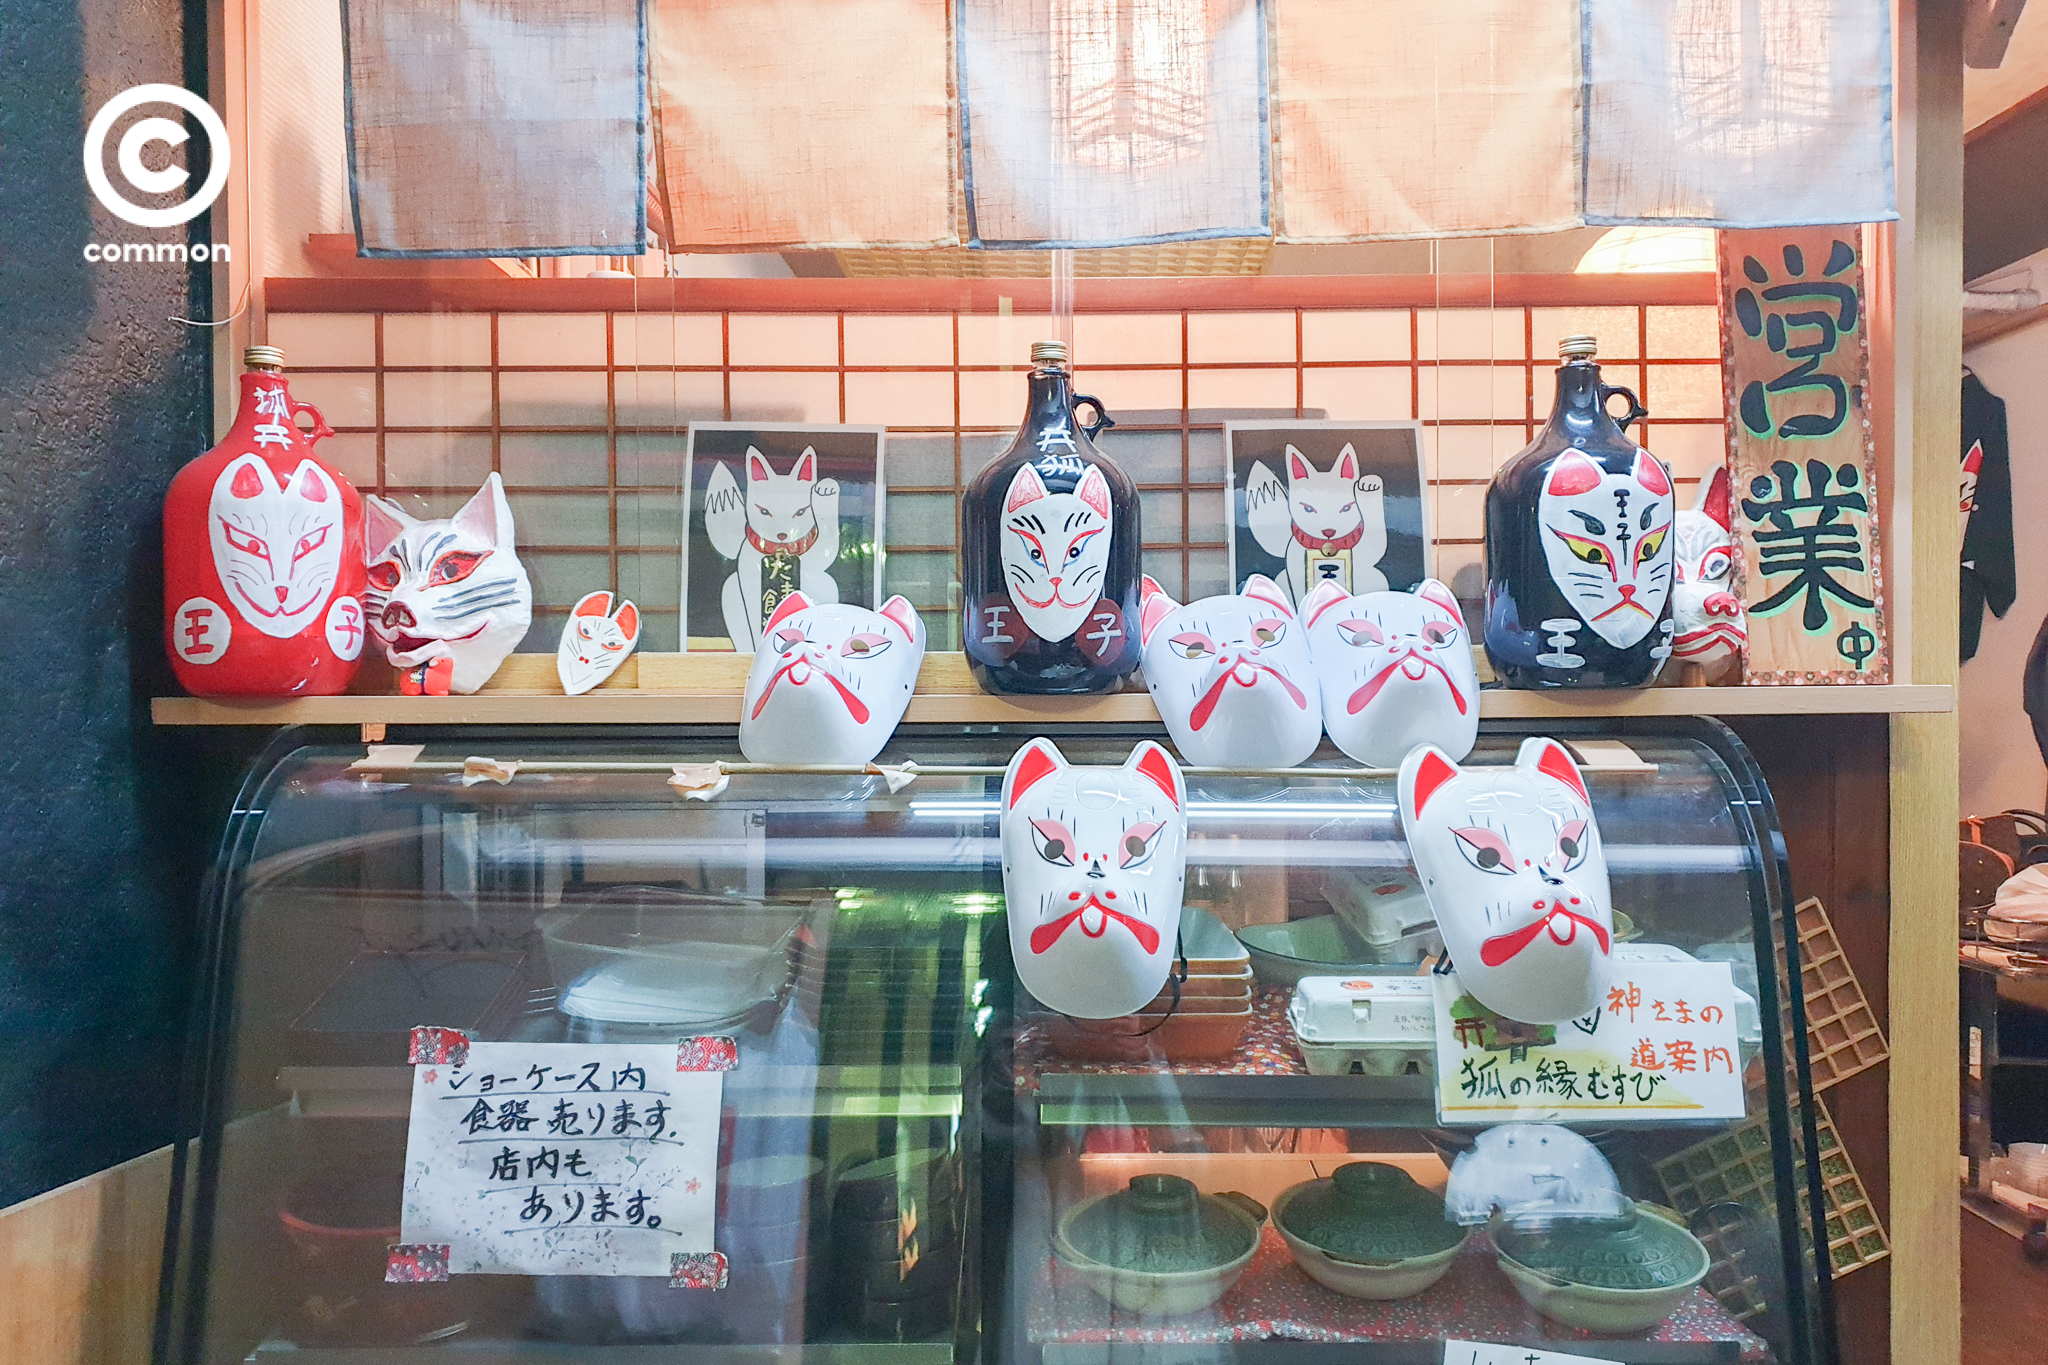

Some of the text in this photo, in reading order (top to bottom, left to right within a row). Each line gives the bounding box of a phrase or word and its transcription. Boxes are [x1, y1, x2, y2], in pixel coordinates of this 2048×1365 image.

[1736, 240, 1877, 670] 営業中
[1613, 489, 1632, 566] 王子
[184, 604, 362, 655] 王 子
[982, 606, 1123, 657] 王 子
[1535, 618, 1586, 669] 王
[1607, 981, 1723, 1024] 神さまの
[449, 1062, 646, 1092] ショーケース内
[1631, 1037, 1734, 1074] 道案内
[1460, 1056, 1666, 1104] 狐の縁むすび
[488, 1146, 592, 1180] 店内も
[519, 1186, 661, 1228] あります。
